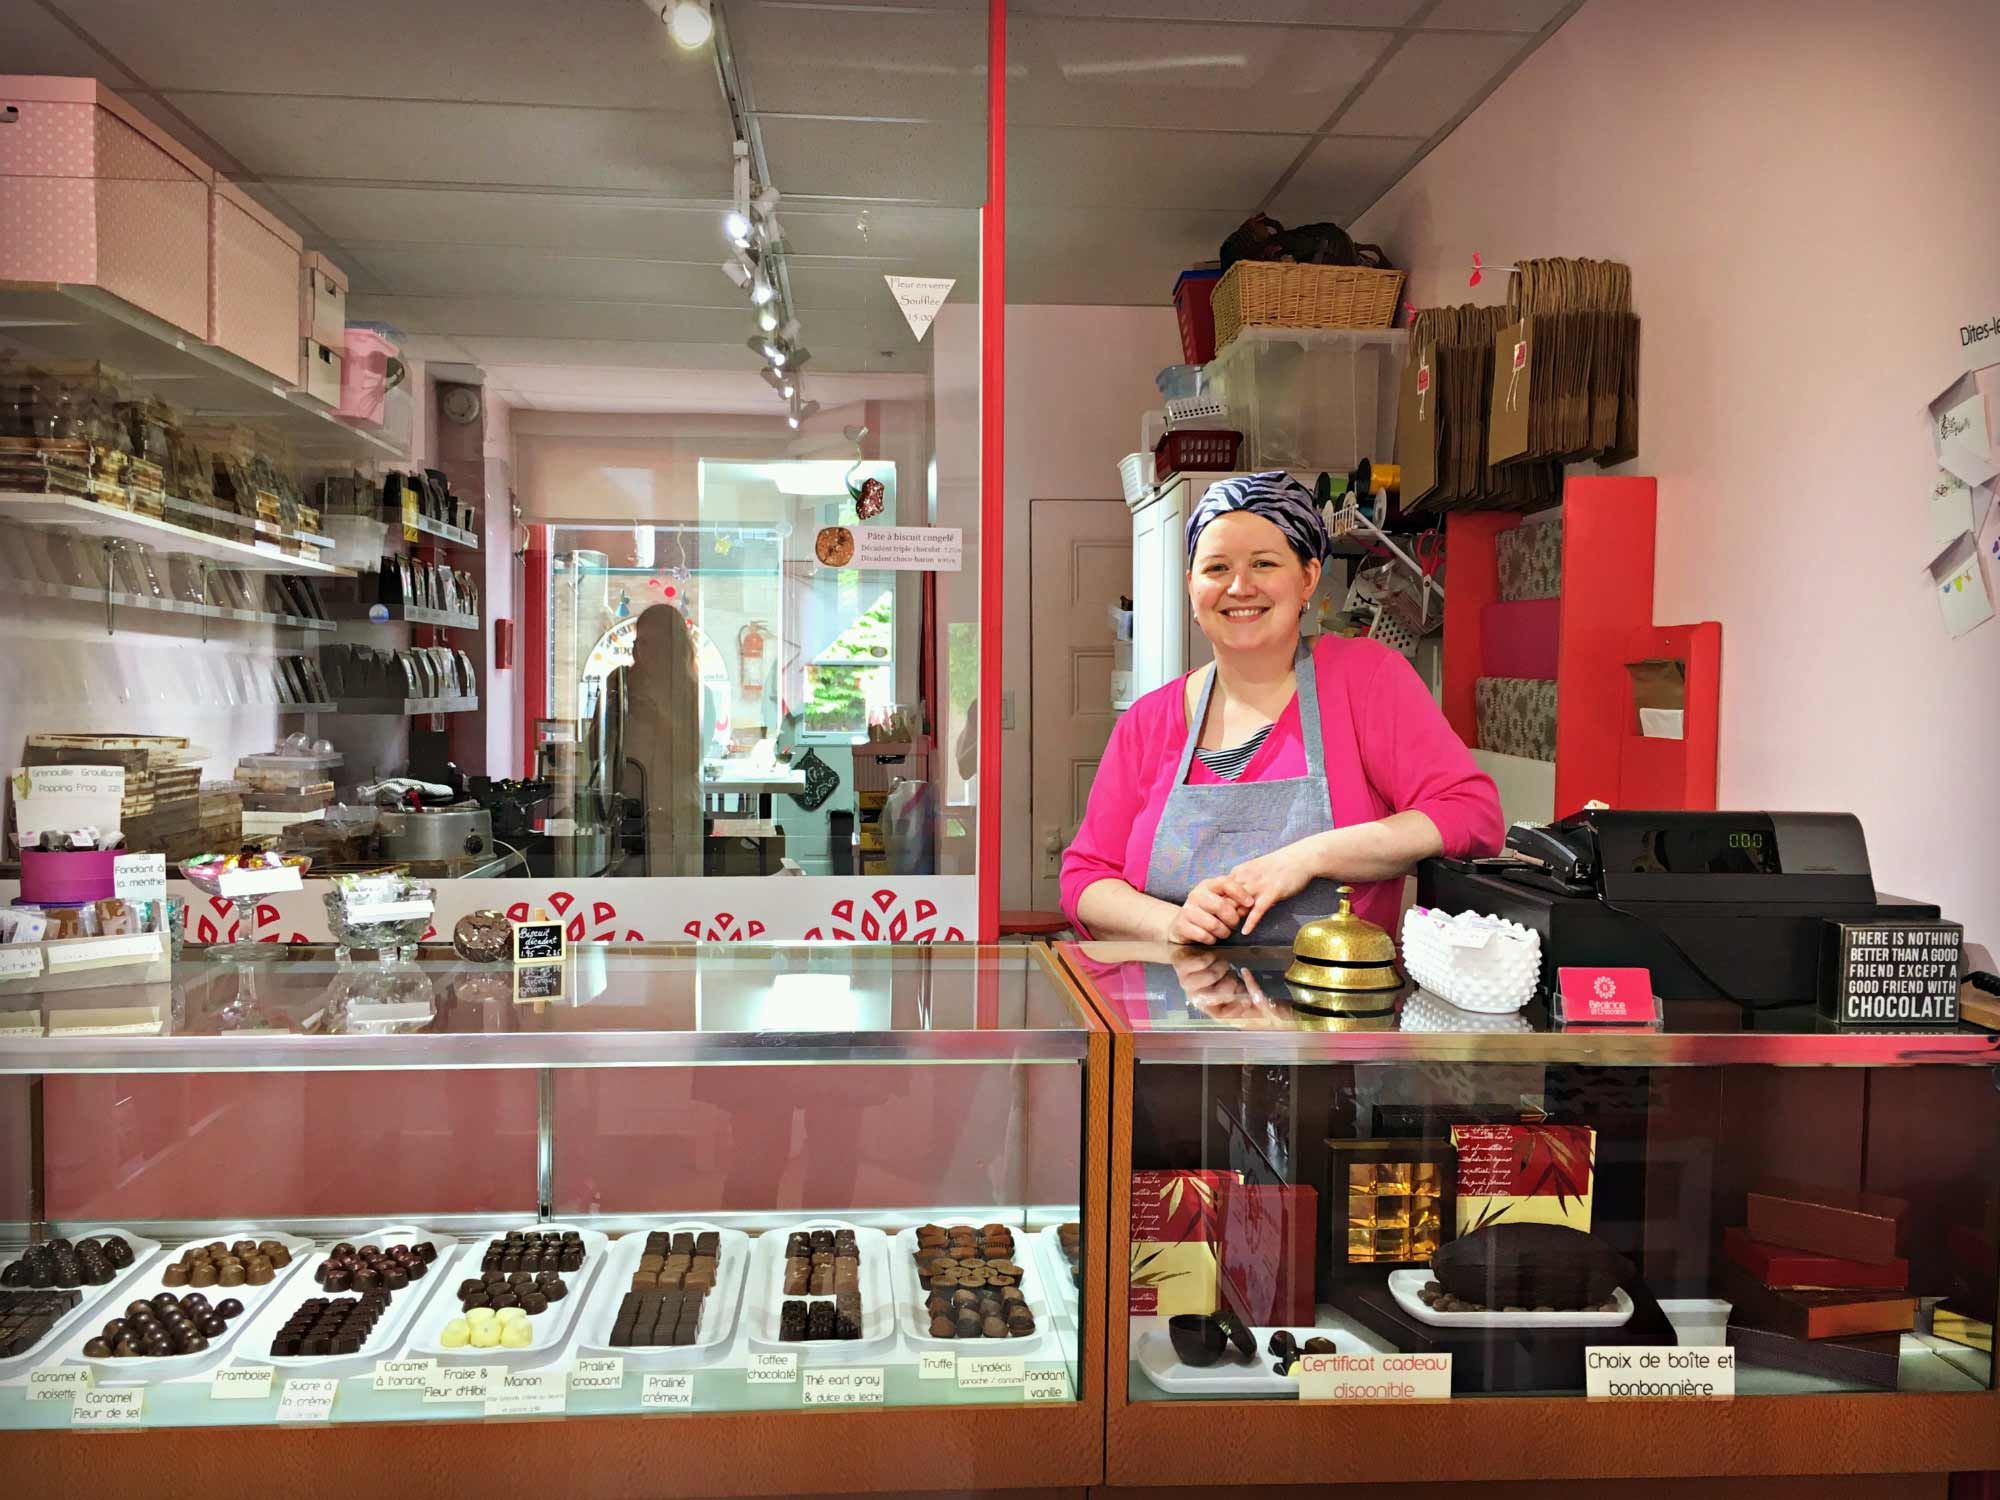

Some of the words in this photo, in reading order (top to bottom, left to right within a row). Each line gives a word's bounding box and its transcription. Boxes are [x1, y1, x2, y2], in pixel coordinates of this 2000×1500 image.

[867, 532, 886, 541] Pâte
[894, 532, 921, 541] biscuit
[115, 865, 154, 874] Fondant
[129, 878, 165, 887] menthe
[519, 928, 550, 938] Biscuit
[1851, 931, 1889, 945] THERE
[1892, 932, 1905, 945] IS
[1908, 931, 1959, 946] NOTHING
[1850, 948, 1889, 962] BETTER
[1891, 948, 1919, 962] THAN
[1921, 948, 1929, 962] A
[1930, 948, 1958, 962] GOOD
[1850, 964, 1894, 978] FRIEND
[1899, 964, 1946, 978] EXCEPT
[1950, 964, 1957, 978] A
[1848, 980, 1879, 994] GOOD
[1882, 980, 1924, 994] FRIEND
[1927, 980, 1957, 994] WITH
[1847, 996, 1955, 1018] CHOCOLATE
[578, 1357, 616, 1372] Praliné
[757, 1355, 789, 1366] Toffee
[922, 1358, 953, 1369] Truffe
[1302, 1355, 1376, 1372] Certificat
[1382, 1355, 1448, 1371] cadeau
[1588, 1352, 1633, 1369] Choix
[1639, 1352, 1661, 1369] de
[1668, 1351, 1710, 1369] boîte
[1717, 1353, 1734, 1369] et
[384, 1361, 429, 1372] Caramel
[971, 1361, 1012, 1373] L'indécis
[30, 1371, 77, 1383] Caramel
[80, 1370, 89, 1382] &
[215, 1370, 272, 1382] Framboise
[443, 1368, 476, 1380] Fraise
[480, 1368, 489, 1379] &
[1024, 1370, 1066, 1381] Fondant
[290, 1380, 321, 1391] Sucre
[376, 1375, 384, 1387] à
[503, 1376, 543, 1387] Manon
[572, 1375, 621, 1387] croquant
[649, 1376, 686, 1389] Praliné
[806, 1375, 825, 1386] Thé
[828, 1375, 850, 1386] earl
[959, 1377, 989, 1386] ganache
[424, 1386, 452, 1398] Fleur
[1030, 1387, 1063, 1399] vanille
[1333, 1382, 1416, 1400] disponible
[1608, 1378, 1714, 1396] bonbonnière
[85, 1391, 133, 1404] Caramel
[643, 1391, 690, 1403] crémeux
[804, 1391, 812, 1402] &
[843, 1391, 856, 1401] de
[73, 1407, 102, 1419] Fleur
[106, 1407, 121, 1418] de
[126, 1406, 141, 1418] sel
